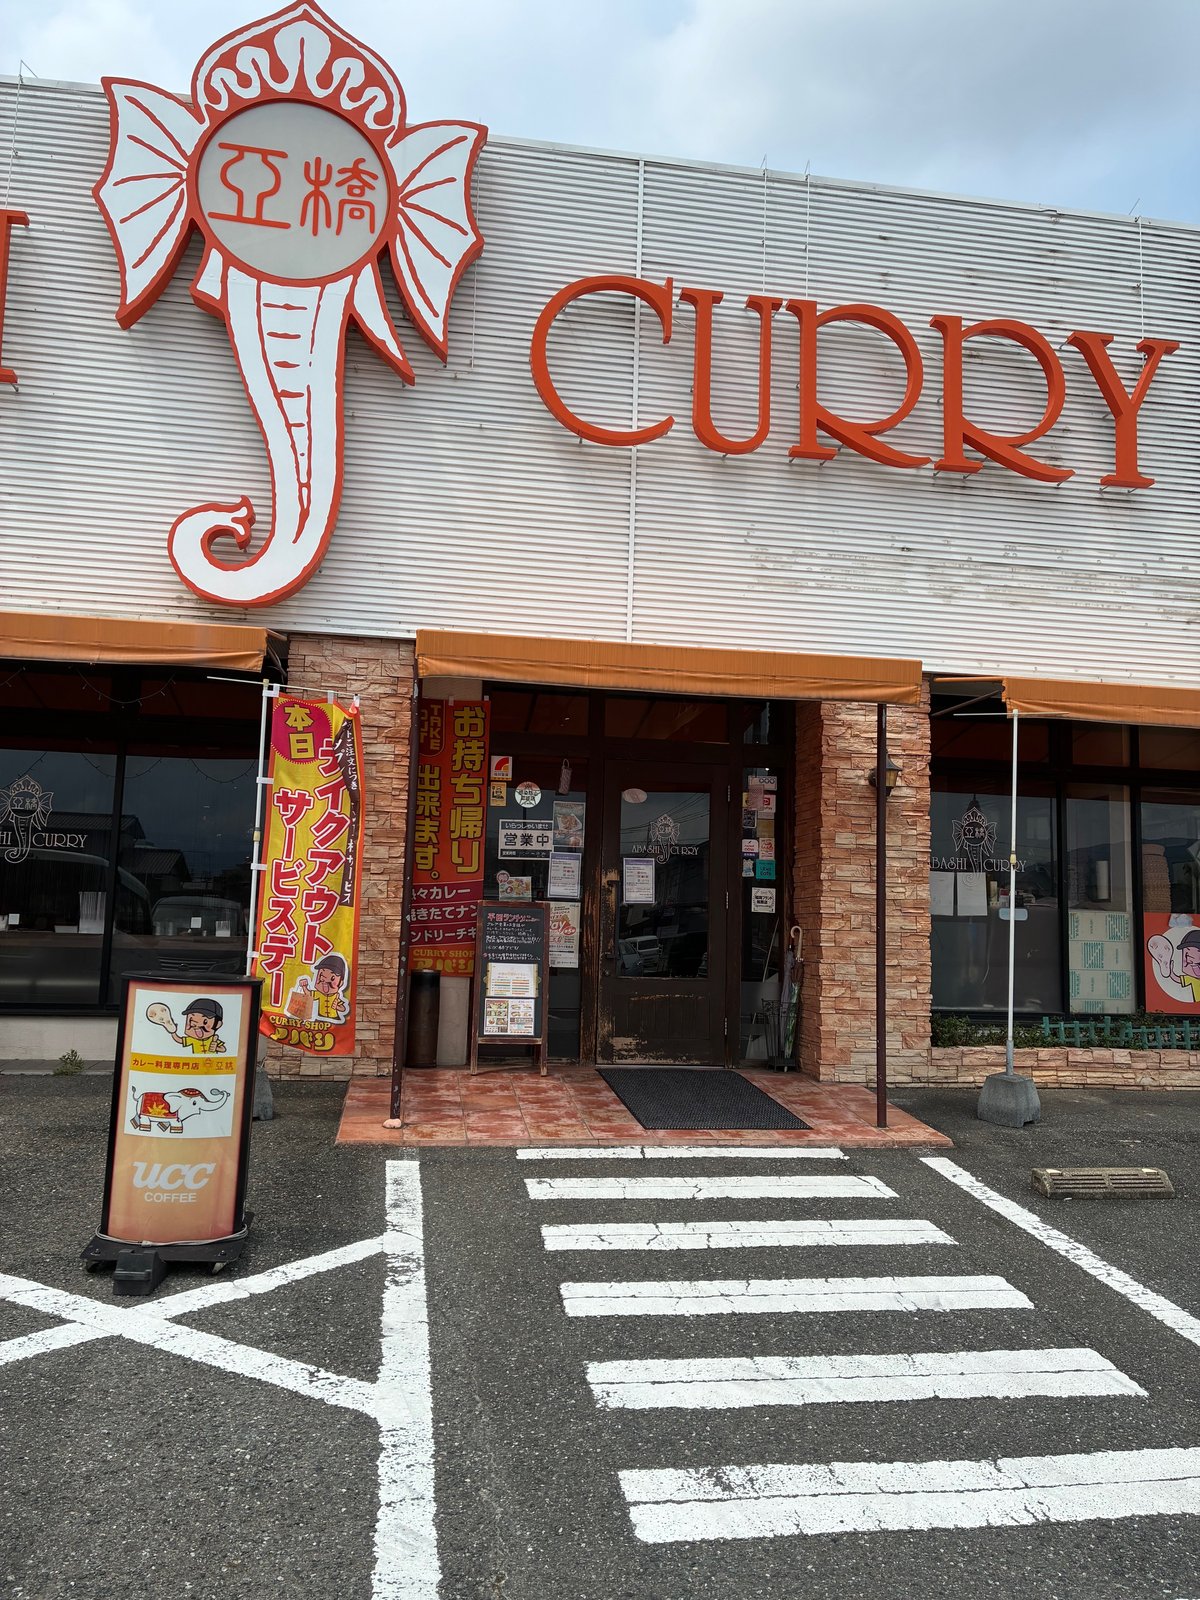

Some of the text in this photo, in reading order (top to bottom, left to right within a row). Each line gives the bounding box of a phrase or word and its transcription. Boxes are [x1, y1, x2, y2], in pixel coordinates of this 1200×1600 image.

[529, 275, 1180, 489] CURRY
[284, 703, 315, 760] 本日
[430, 704, 441, 750] TAKE
[450, 705, 486, 874] お持ち帰り
[415, 764, 441, 880] 出来ます。
[505, 822, 549, 830] いらっしゃいませ
[32, 832, 88, 848] CURRY
[504, 832, 549, 847] 営業中
[632, 844, 699, 856] ABASHI CURRY
[261, 787, 314, 1007] サービスデー
[413, 948, 447, 957] CURRY
[269, 1015, 331, 1031] CURRY SHOP
[132, 1057, 200, 1070] カレー料理専門店
[132, 1161, 217, 1190] UCC
[144, 1192, 197, 1203] COFFEE
